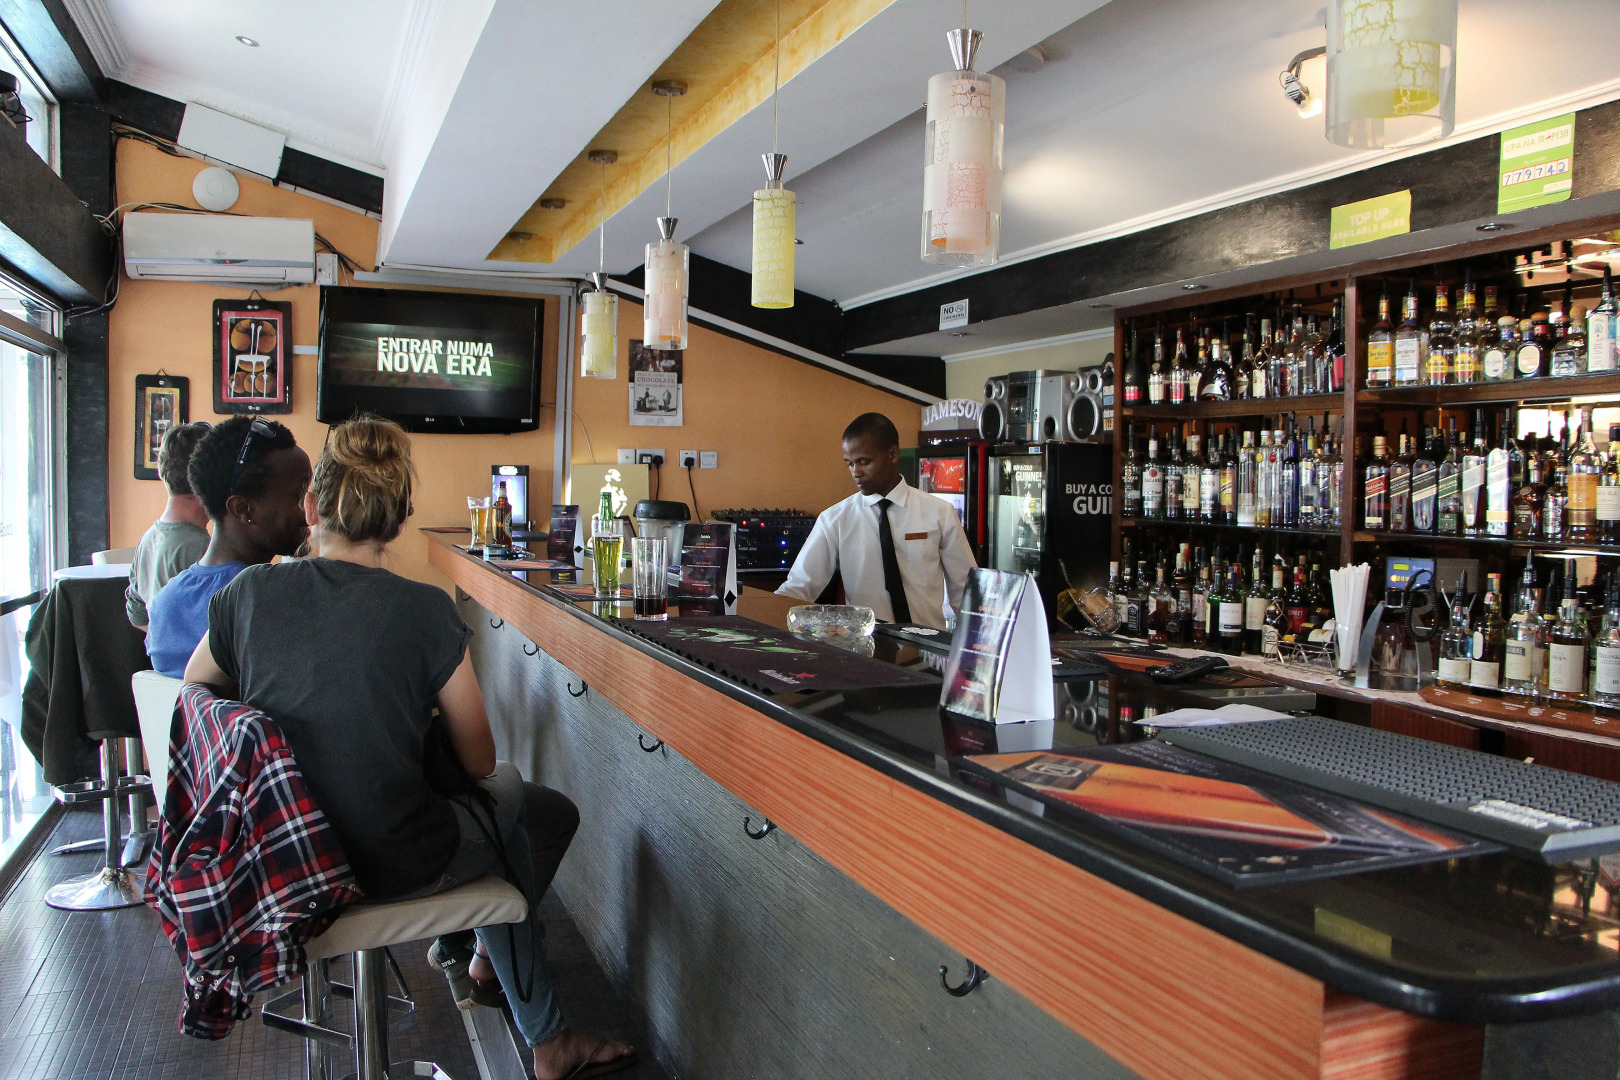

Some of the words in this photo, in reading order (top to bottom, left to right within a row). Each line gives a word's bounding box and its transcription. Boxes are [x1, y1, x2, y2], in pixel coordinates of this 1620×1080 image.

[1523, 139, 1536, 148] NA
[1503, 161, 1566, 186] 779742
[1350, 211, 1372, 226] TOP
[1374, 207, 1390, 221] UP
[1333, 223, 1379, 240] AVAILABLE
[1381, 217, 1406, 230] HERE
[943, 306, 954, 315] NO
[377, 336, 443, 354] ENTRAR
[446, 340, 494, 357] NUMA
[377, 351, 439, 374] NOVA
[446, 354, 493, 377] ERA
[923, 399, 980, 426] JAMESON
[1065, 483, 1087, 494] BUY
[1089, 484, 1097, 494] A
